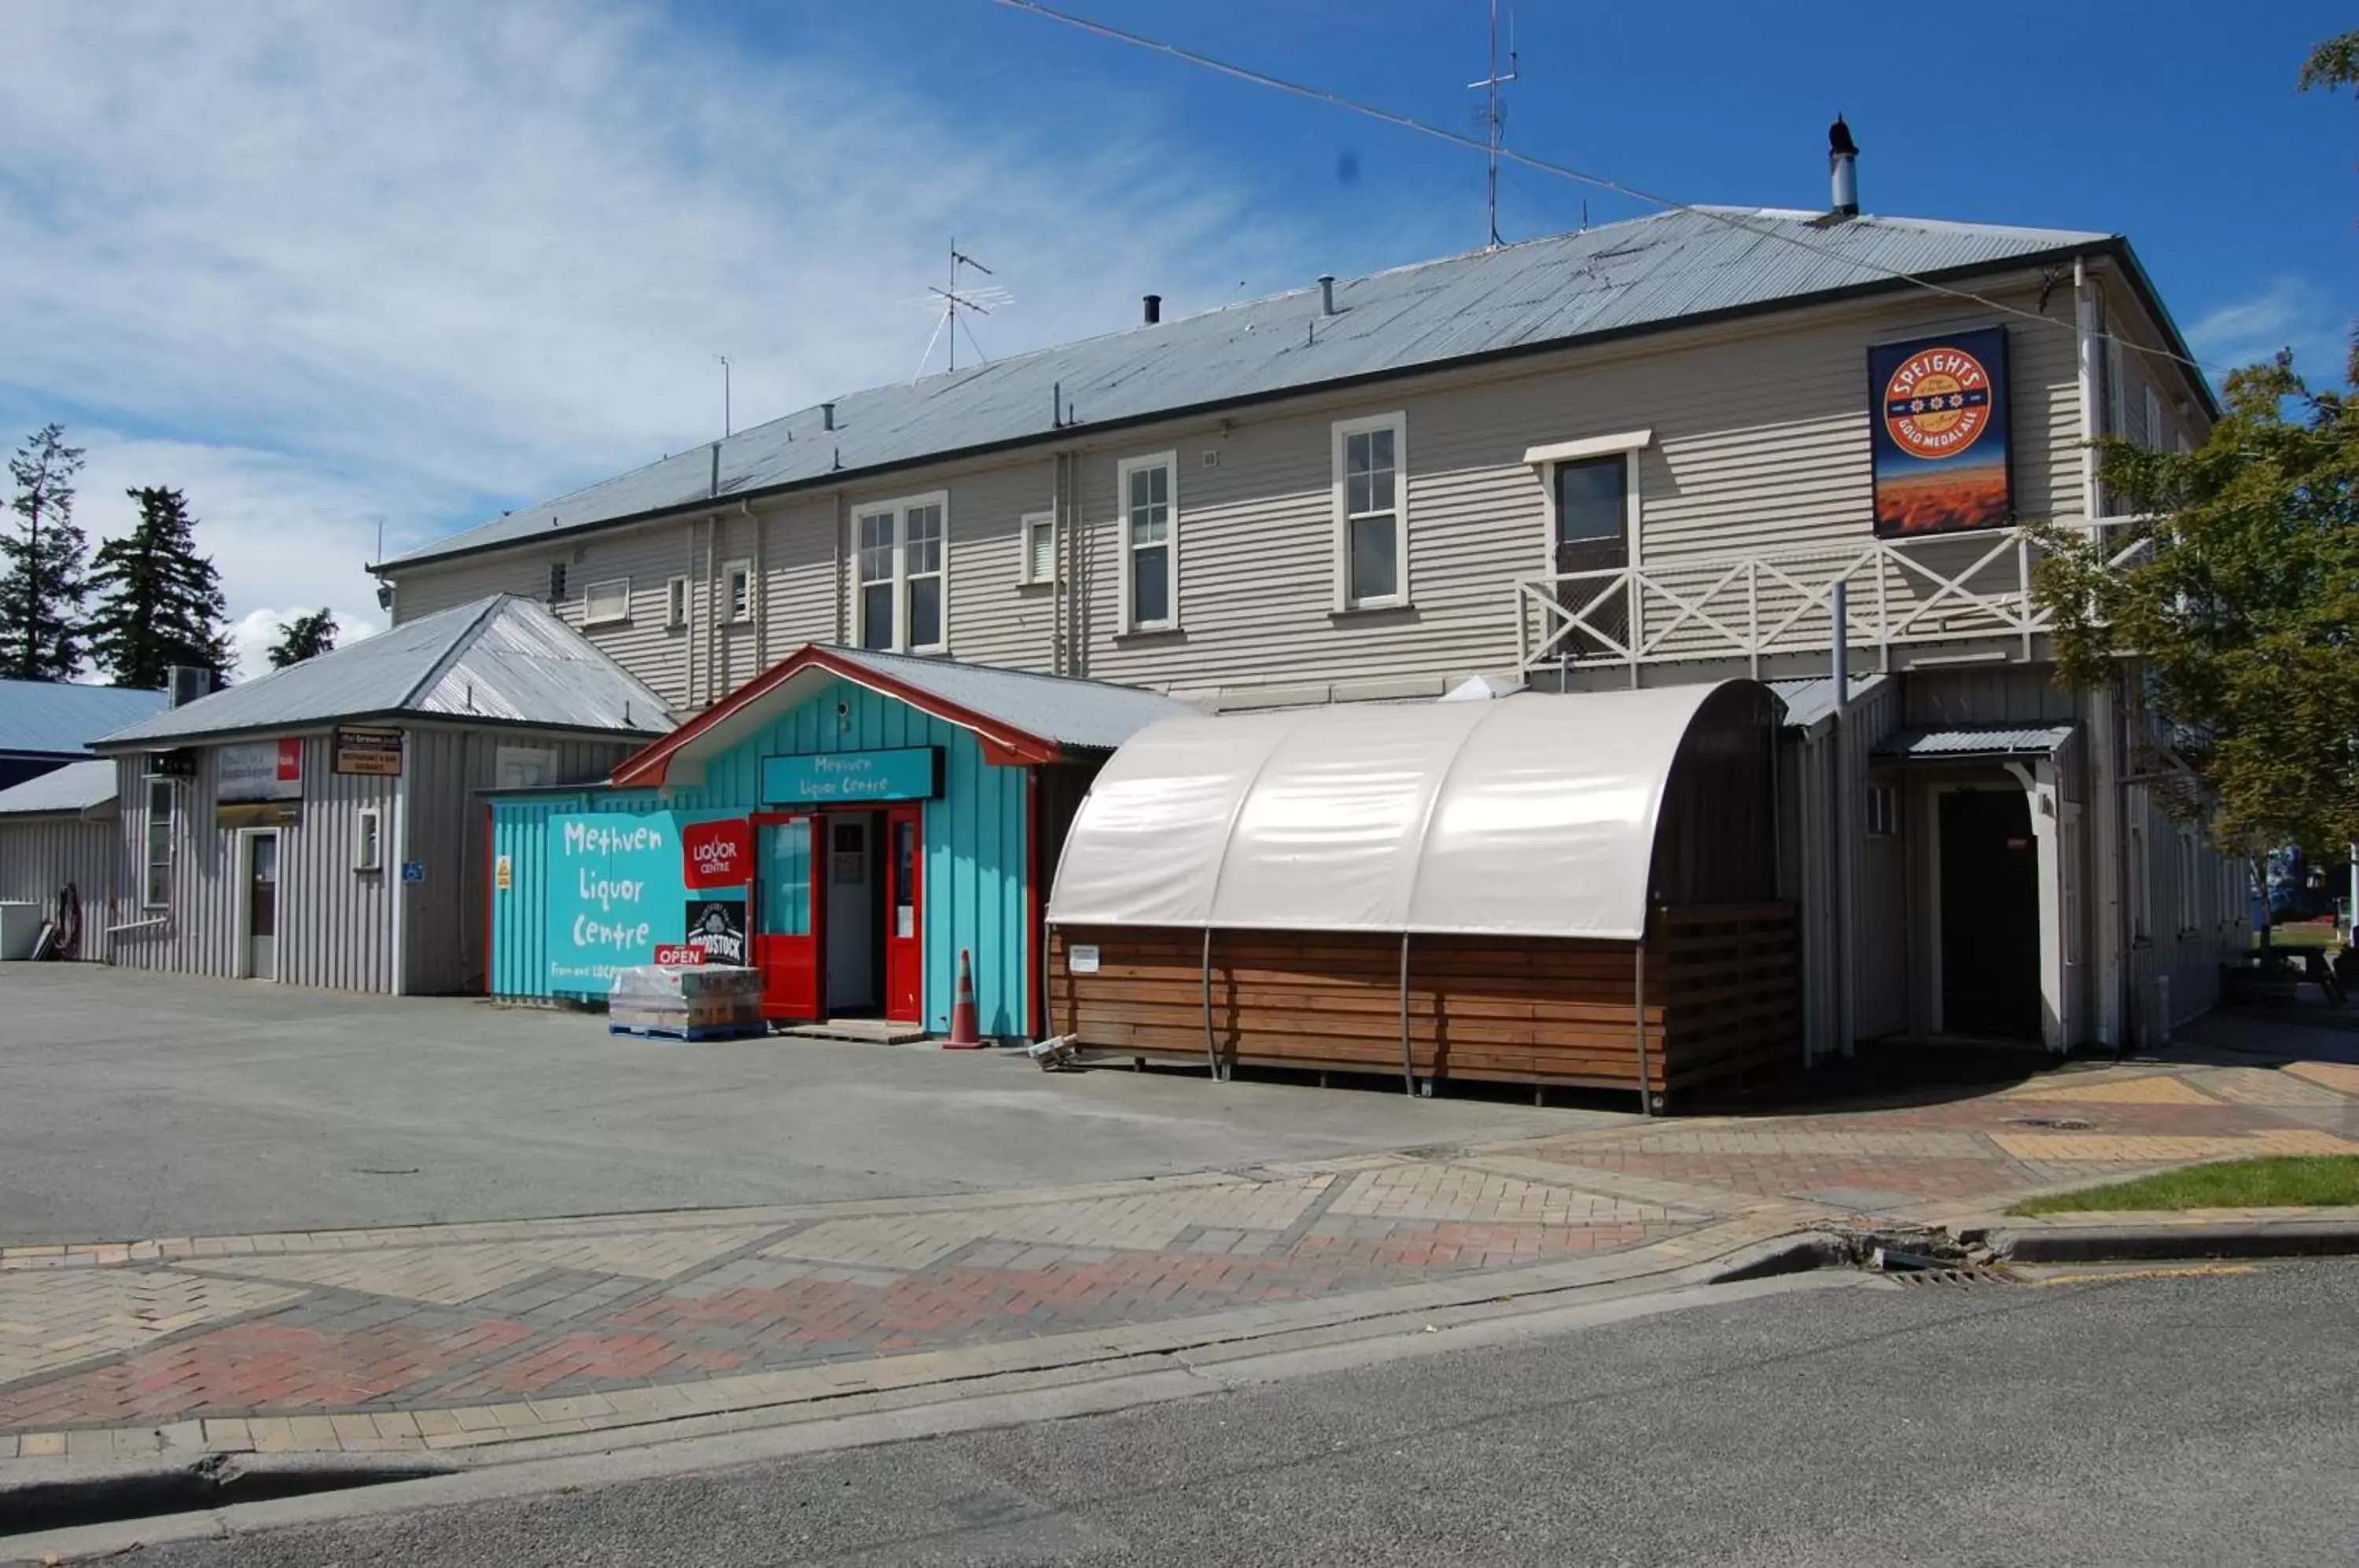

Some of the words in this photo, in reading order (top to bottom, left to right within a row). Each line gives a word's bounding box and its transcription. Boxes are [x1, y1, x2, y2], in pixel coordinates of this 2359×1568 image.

[1899, 419, 1922, 443] GOLD
[1923, 429, 1963, 447] MEDAL
[1960, 411, 1977, 432] ALE
[800, 778, 837, 800] Liquor
[842, 776, 889, 794] Centre
[564, 820, 662, 856] Methven
[693, 841, 738, 861] LIQUOR
[701, 861, 730, 874] CENTRE
[580, 867, 645, 912] Liquor
[573, 914, 650, 951] Centre
[660, 950, 699, 964] OPEN
